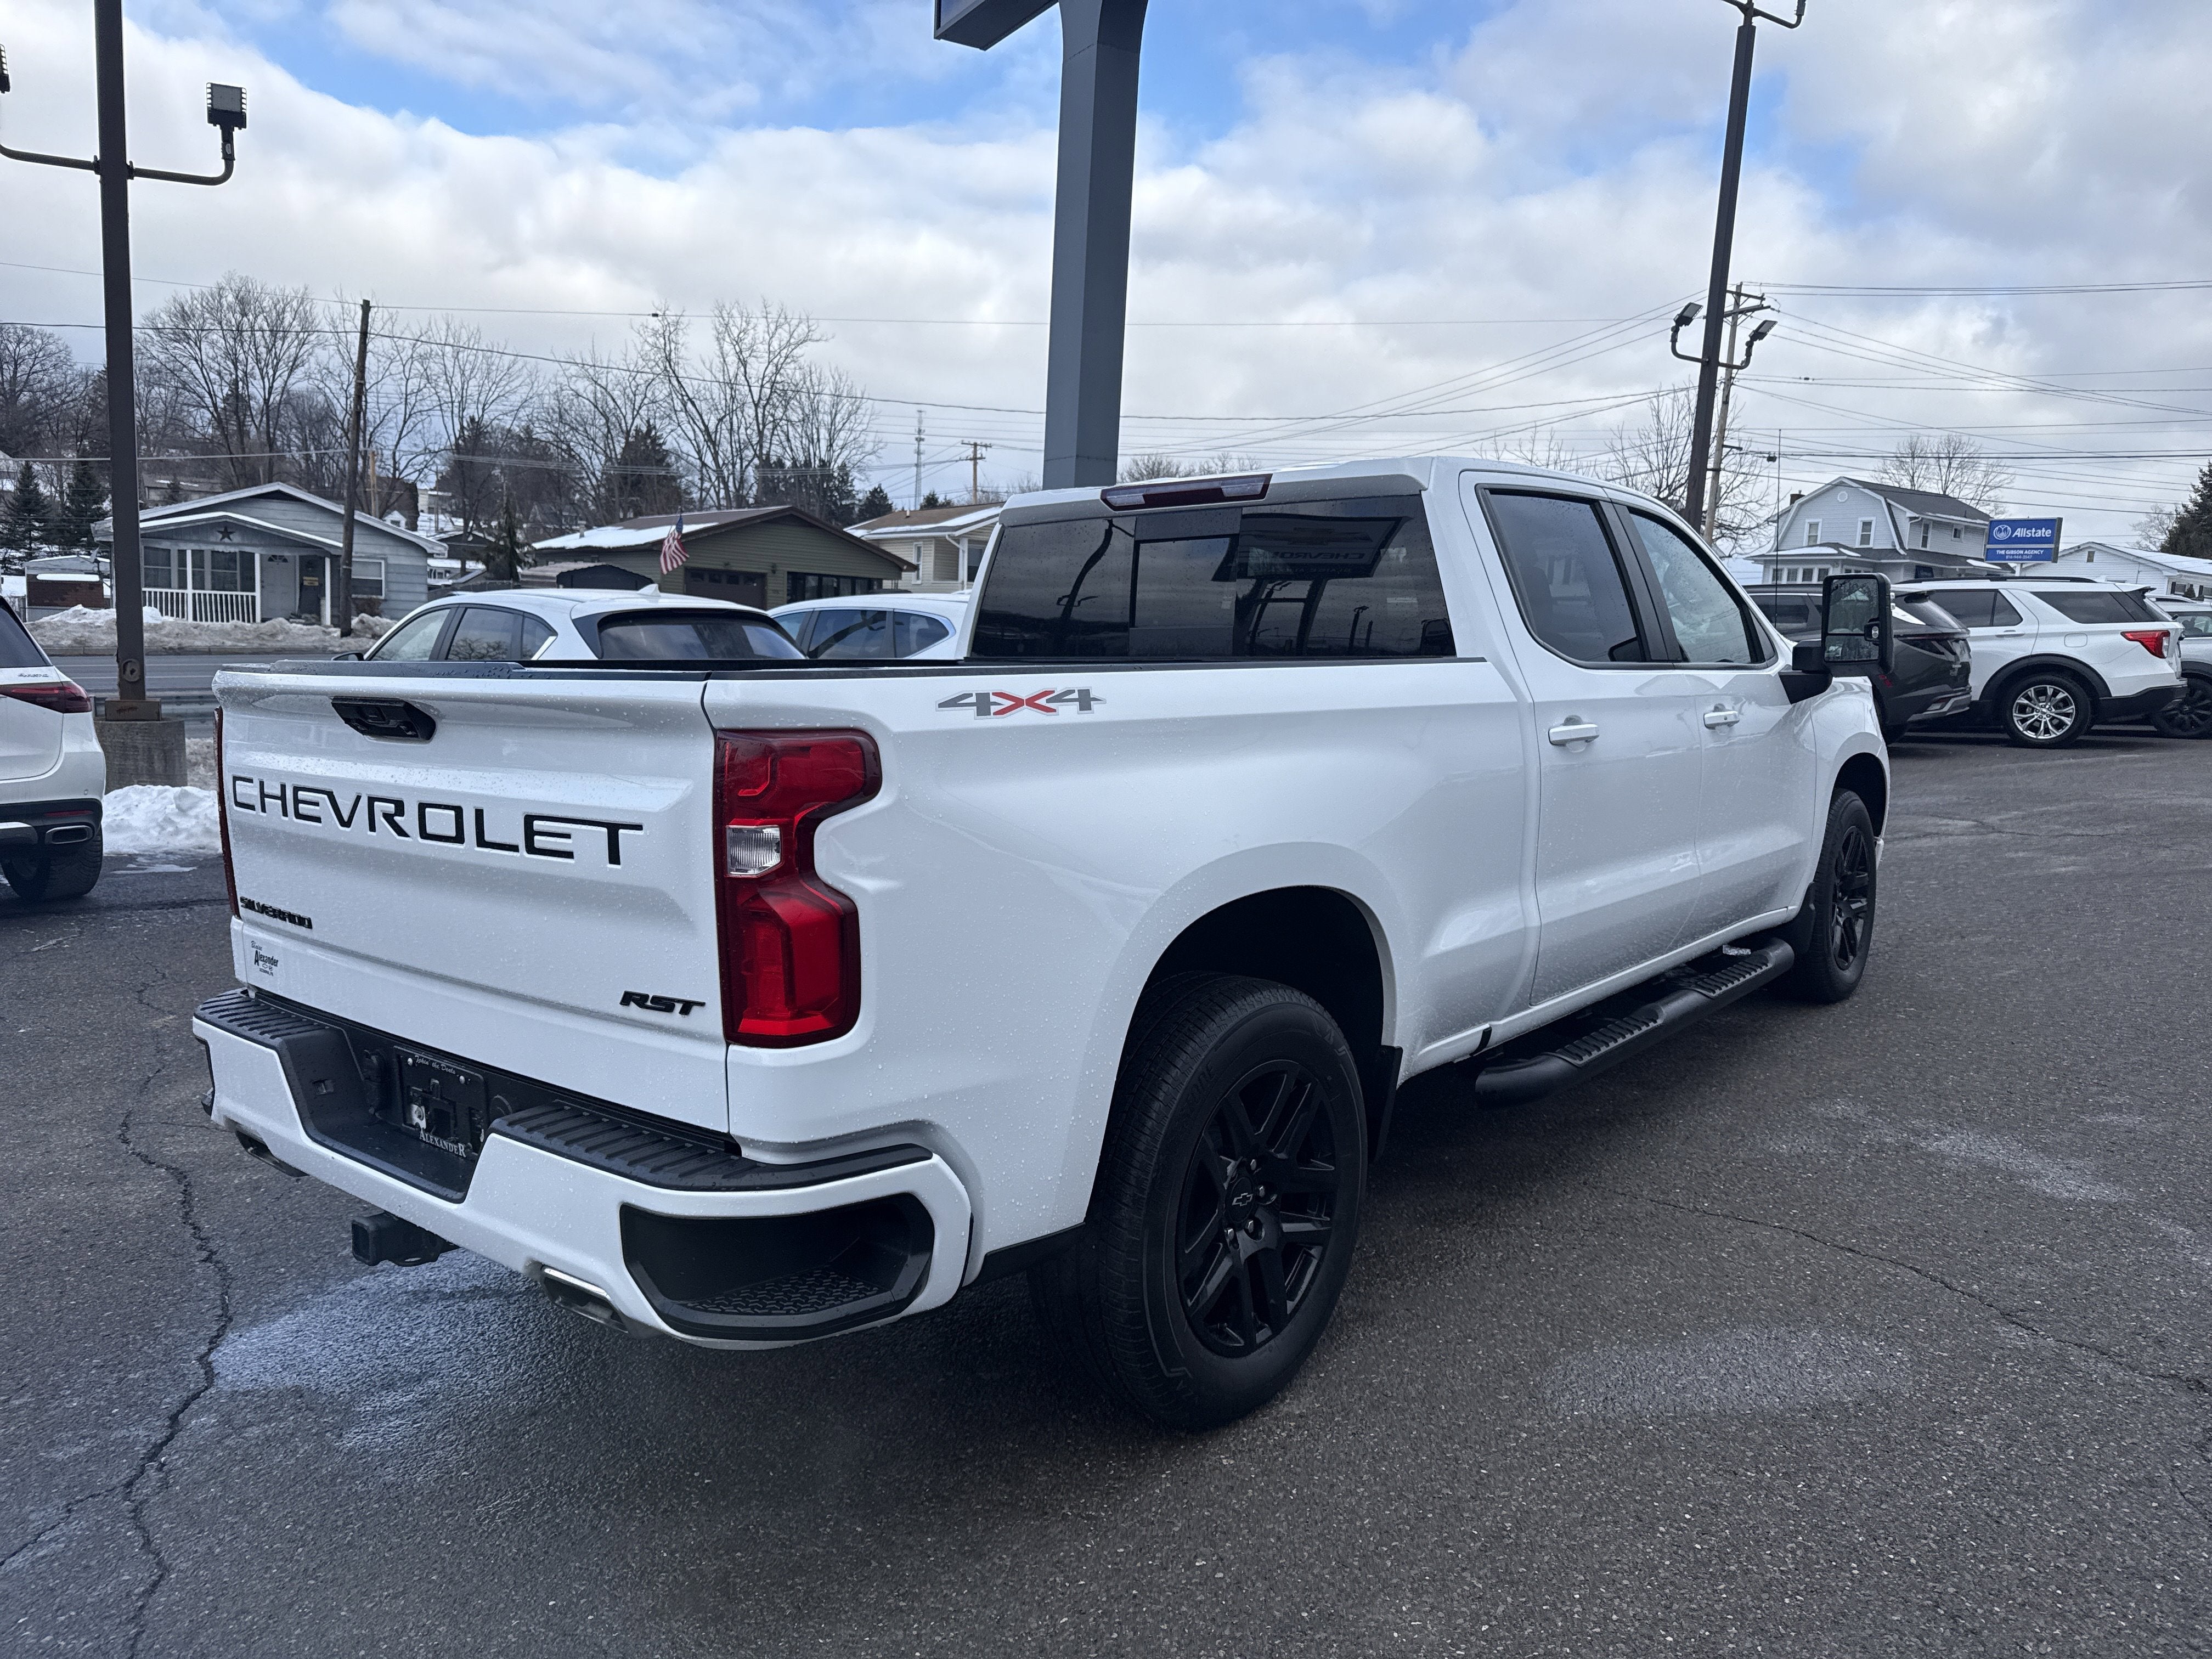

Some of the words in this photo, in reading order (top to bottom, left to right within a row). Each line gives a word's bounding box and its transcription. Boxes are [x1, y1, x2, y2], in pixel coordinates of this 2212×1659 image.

[2012, 527, 2052, 538] Allstate
[232, 774, 644, 867] CHEVROLET
[240, 896, 313, 929] SILVERADO
[254, 950, 279, 967] Alexander
[620, 990, 706, 1016] RST
[419, 1127, 466, 1158] ALEXANDER
